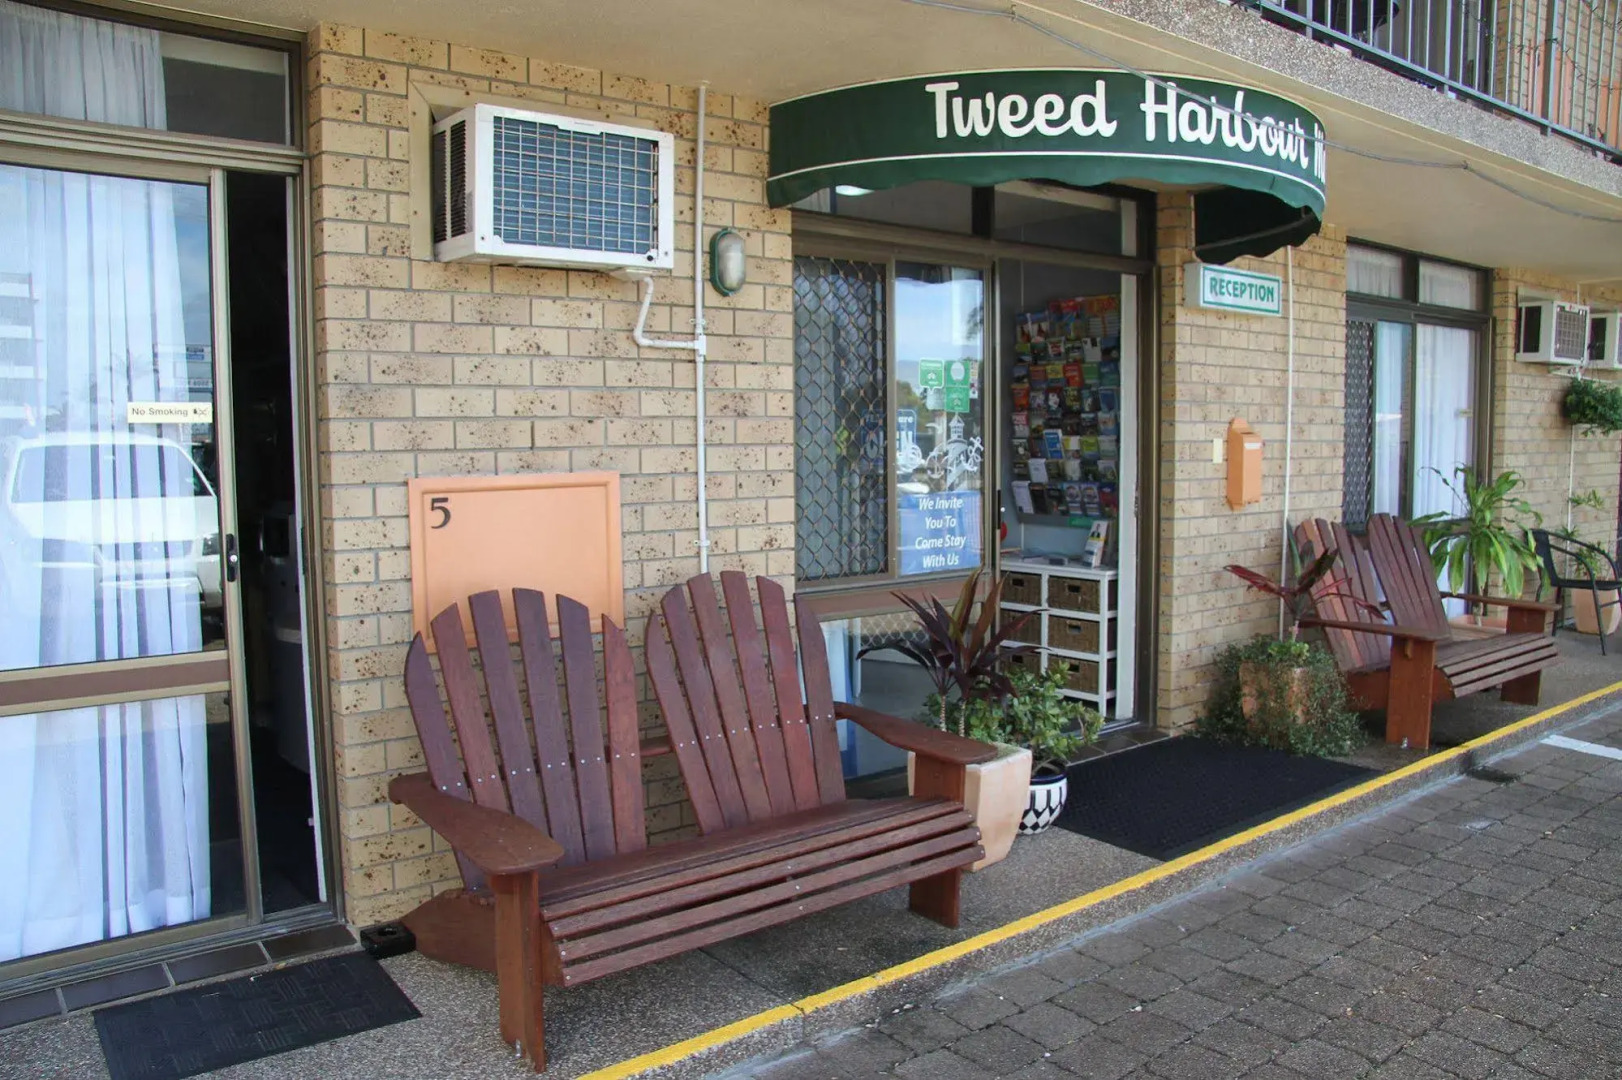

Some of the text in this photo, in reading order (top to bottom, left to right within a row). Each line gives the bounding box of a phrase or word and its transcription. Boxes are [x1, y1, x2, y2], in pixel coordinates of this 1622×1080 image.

[925, 80, 1117, 138] Tweed
[1140, 80, 1309, 169] Harbour
[1209, 276, 1275, 303] RECEPTION
[132, 407, 189, 418] No Smoking
[918, 496, 964, 511] We Invite
[430, 497, 451, 529] 5
[925, 515, 957, 530] You To
[915, 534, 967, 550] Come Stay
[922, 553, 960, 569] With Us
